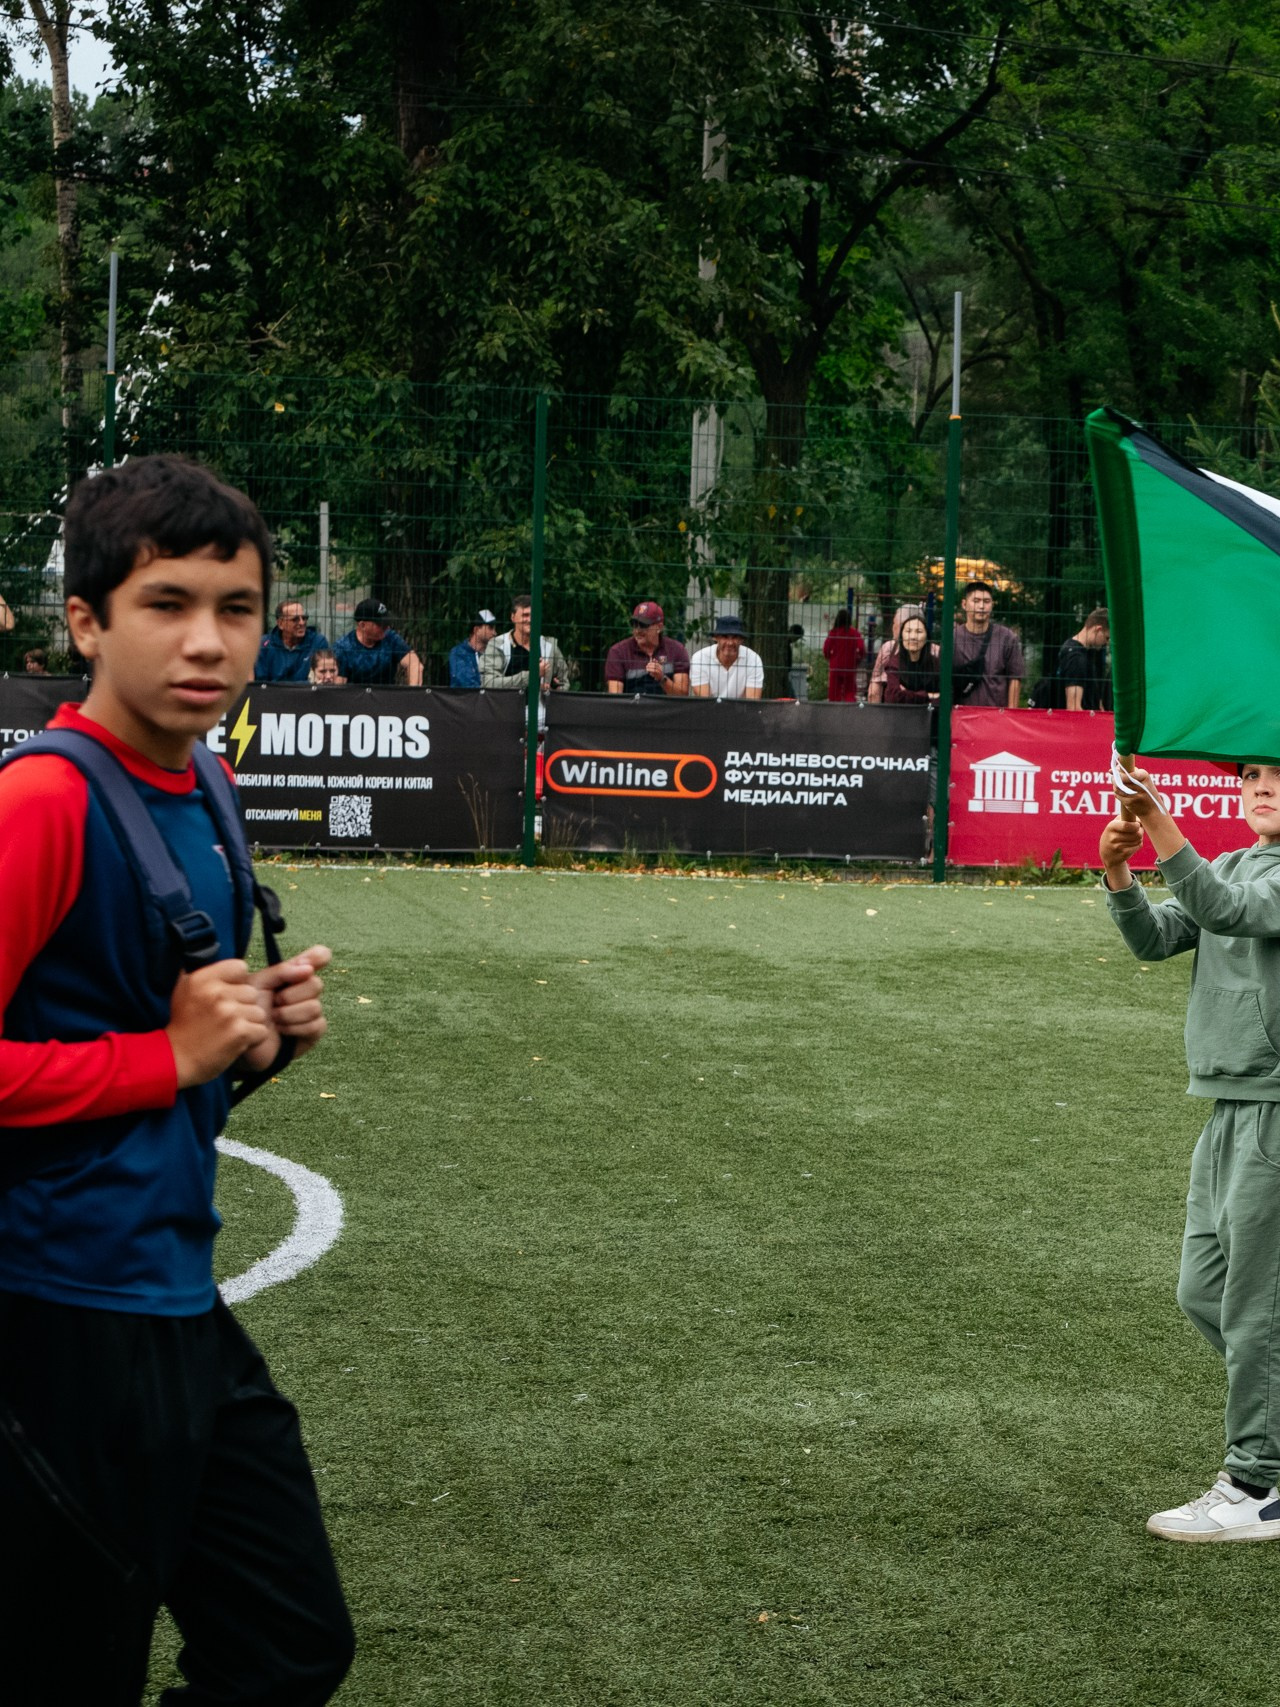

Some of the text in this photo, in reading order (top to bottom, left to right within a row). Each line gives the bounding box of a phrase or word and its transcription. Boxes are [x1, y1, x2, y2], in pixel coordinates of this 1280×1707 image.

[260, 712, 431, 759] MOTORS
[725, 751, 929, 772] ДАЛЬНЕВОСТОЧНАЯ
[273, 775, 286, 788] ИЗ
[287, 775, 326, 789] ЯПОНИИ,
[327, 774, 364, 789] ЮЖНОЙ
[365, 776, 394, 790] КОРЕИ
[395, 777, 403, 789] И
[404, 777, 433, 790] КИТАЯ
[561, 760, 668, 787] Winline
[725, 769, 864, 788] ФУТБОЛЬНАЯ
[724, 789, 848, 806] МЕДИАЛИГА
[245, 808, 322, 821] ОТСКАНИРУЙ МЕНЯ
